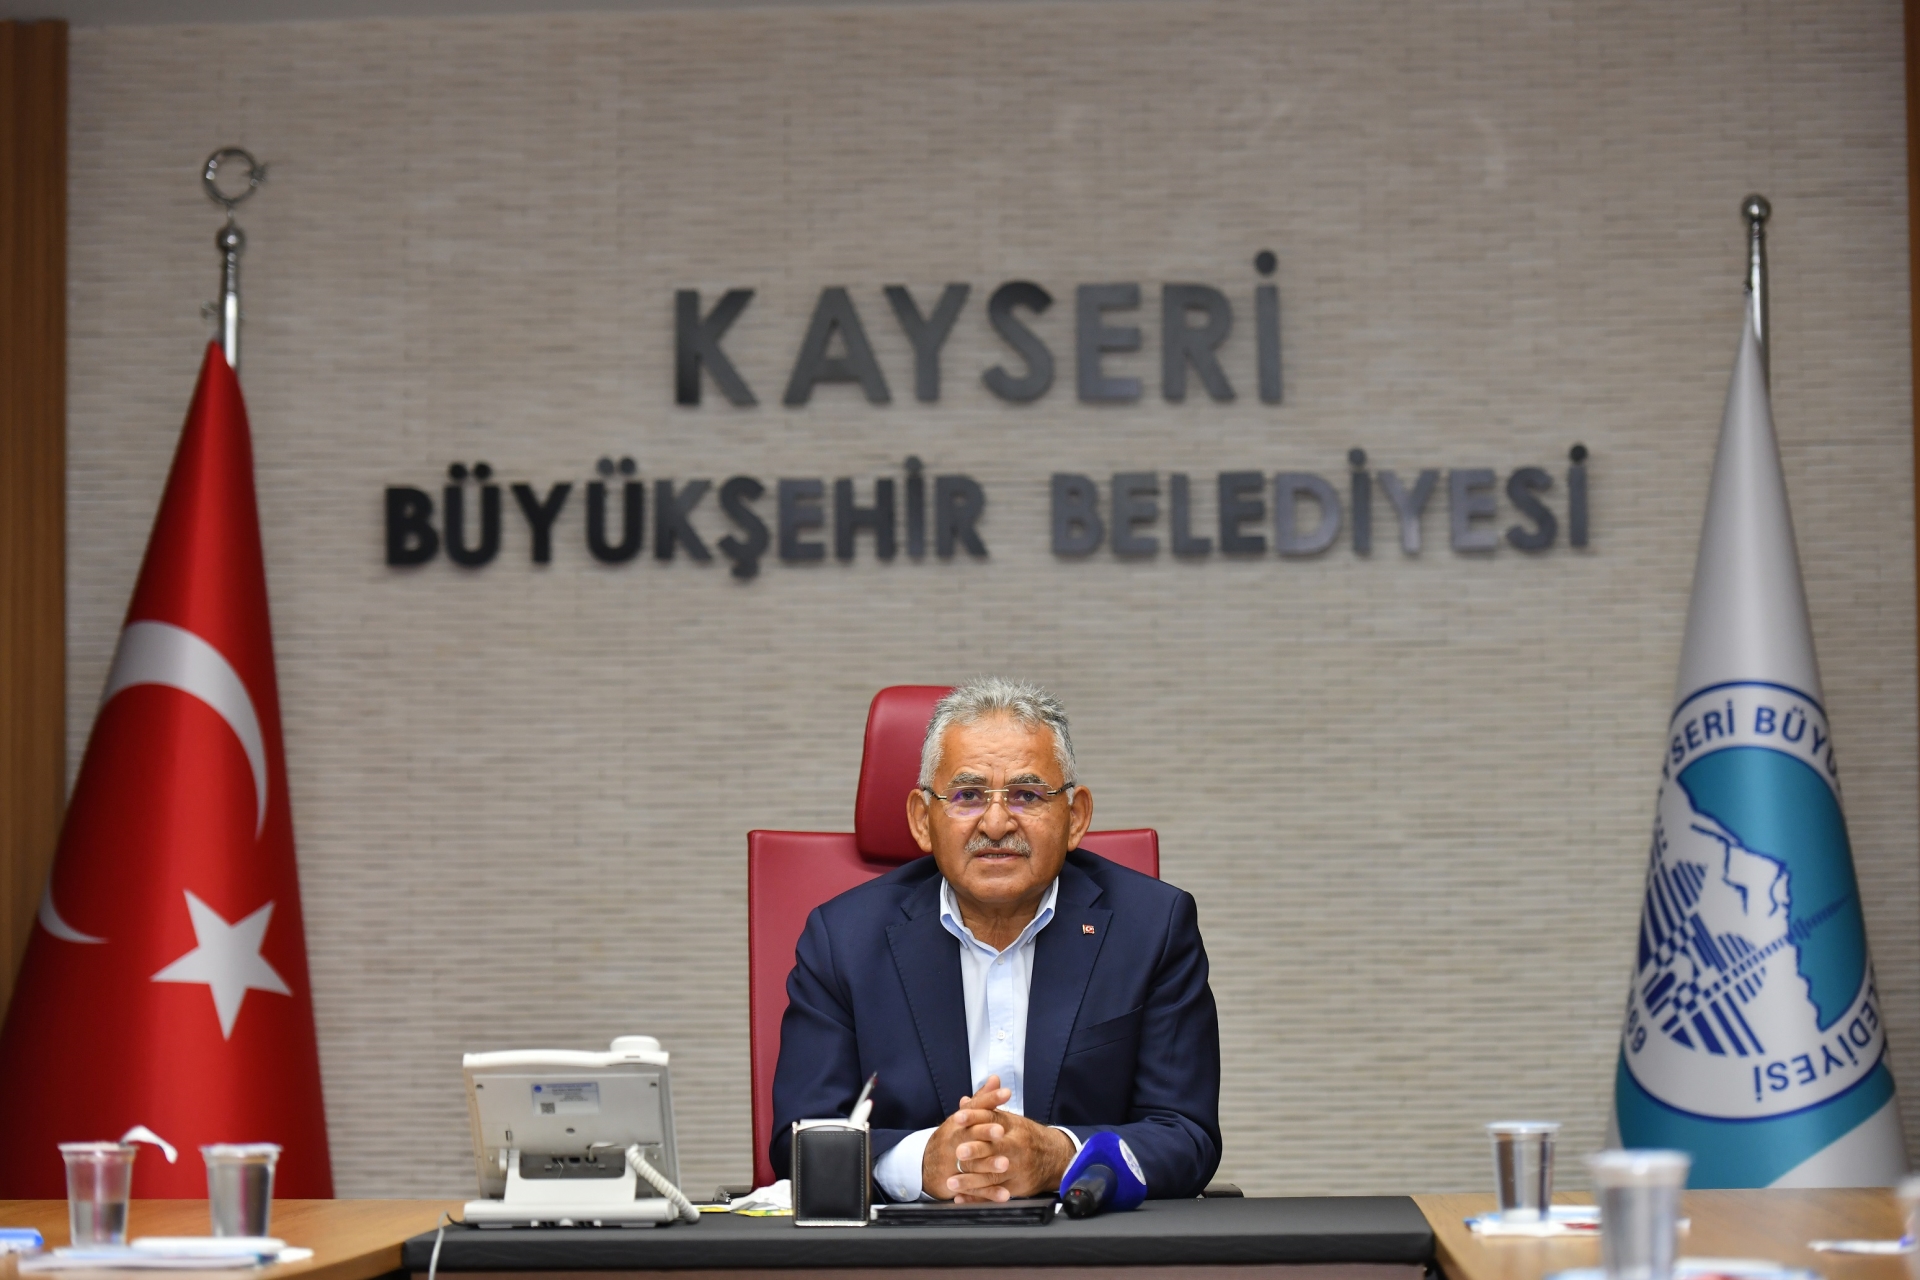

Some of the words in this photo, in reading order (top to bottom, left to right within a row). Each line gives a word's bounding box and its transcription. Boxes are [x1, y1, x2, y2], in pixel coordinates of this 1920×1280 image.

[674, 250, 1284, 406] KAYSERİ
[385, 455, 987, 579] BÜYÜKŞEHİR
[1051, 443, 1590, 557] BELEDİYESİ
